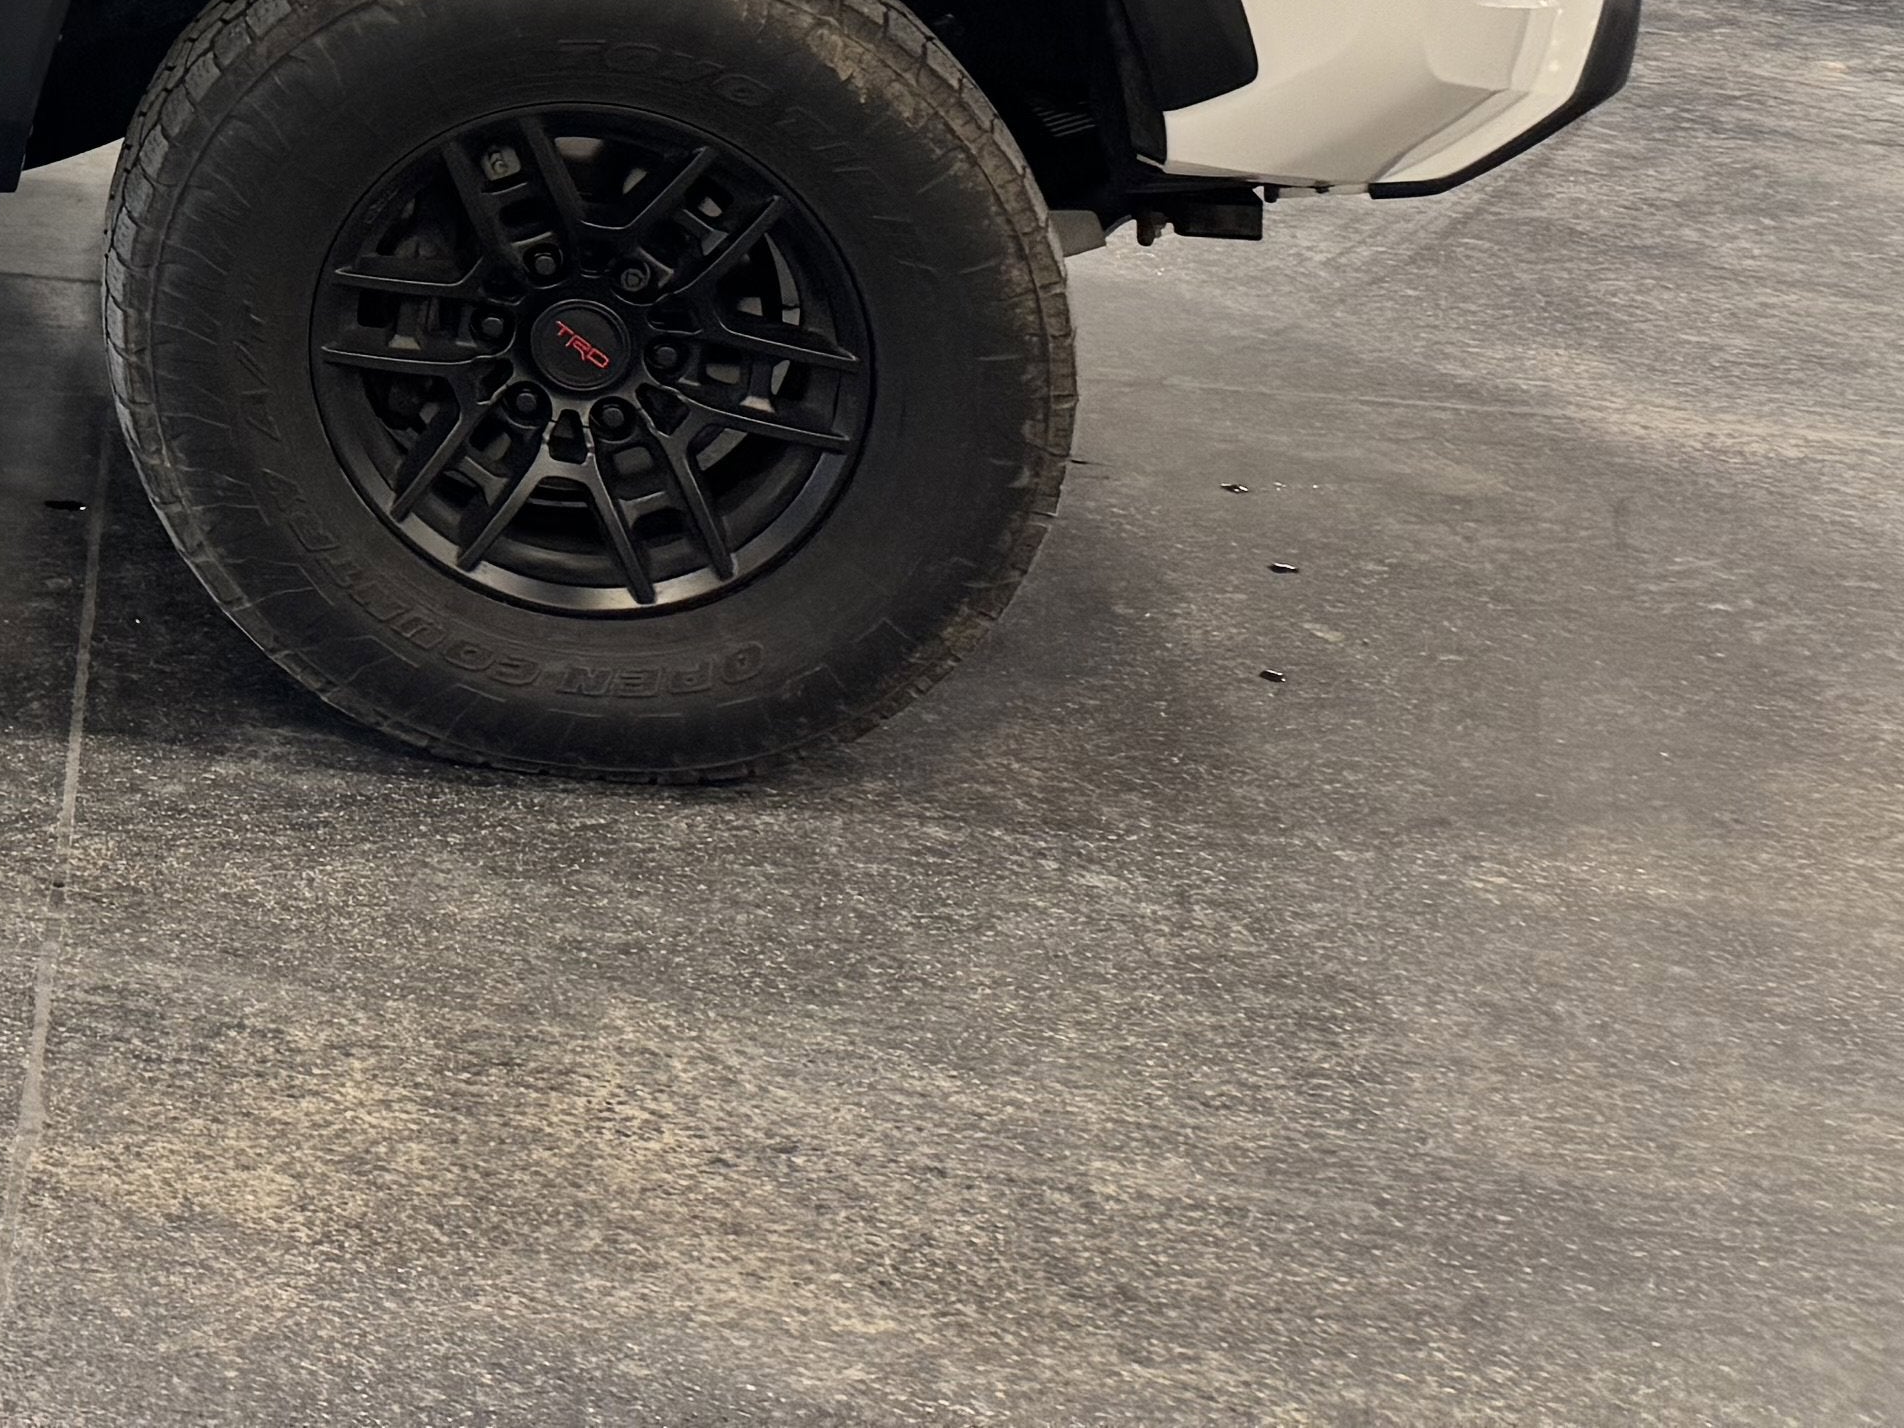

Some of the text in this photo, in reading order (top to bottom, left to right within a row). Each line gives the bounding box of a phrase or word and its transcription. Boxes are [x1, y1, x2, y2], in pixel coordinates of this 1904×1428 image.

[555, 320, 610, 369] TRD
[261, 466, 543, 687] COUNTRY
[556, 640, 765, 698] OPEN
